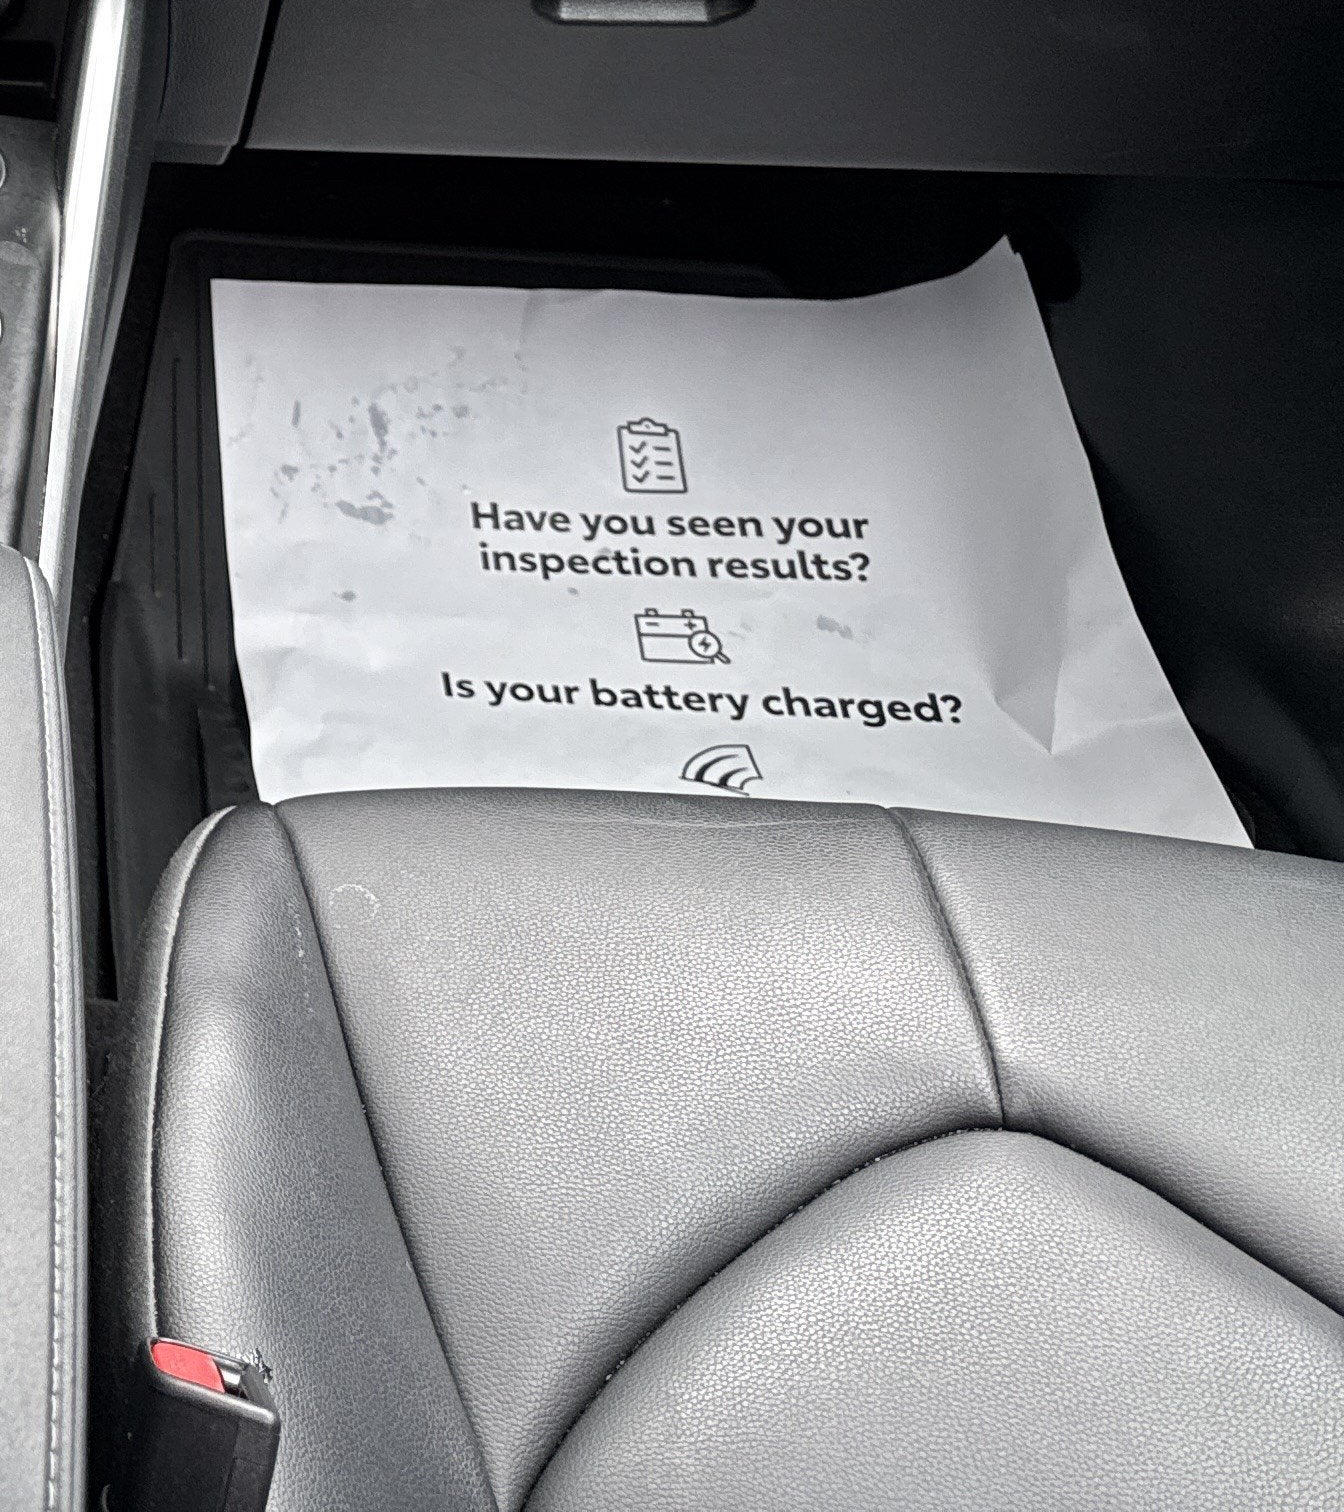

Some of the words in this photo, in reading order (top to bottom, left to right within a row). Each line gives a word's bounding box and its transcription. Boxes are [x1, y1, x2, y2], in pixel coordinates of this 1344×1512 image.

[470, 501, 572, 534] Have
[579, 512, 656, 543] you
[667, 516, 764, 539] seen
[772, 515, 870, 545] your
[479, 542, 697, 580] inspection
[708, 549, 872, 582] results?
[440, 672, 476, 699] Is
[485, 678, 580, 707] your
[589, 679, 750, 721] battery
[762, 687, 964, 728] charged?
